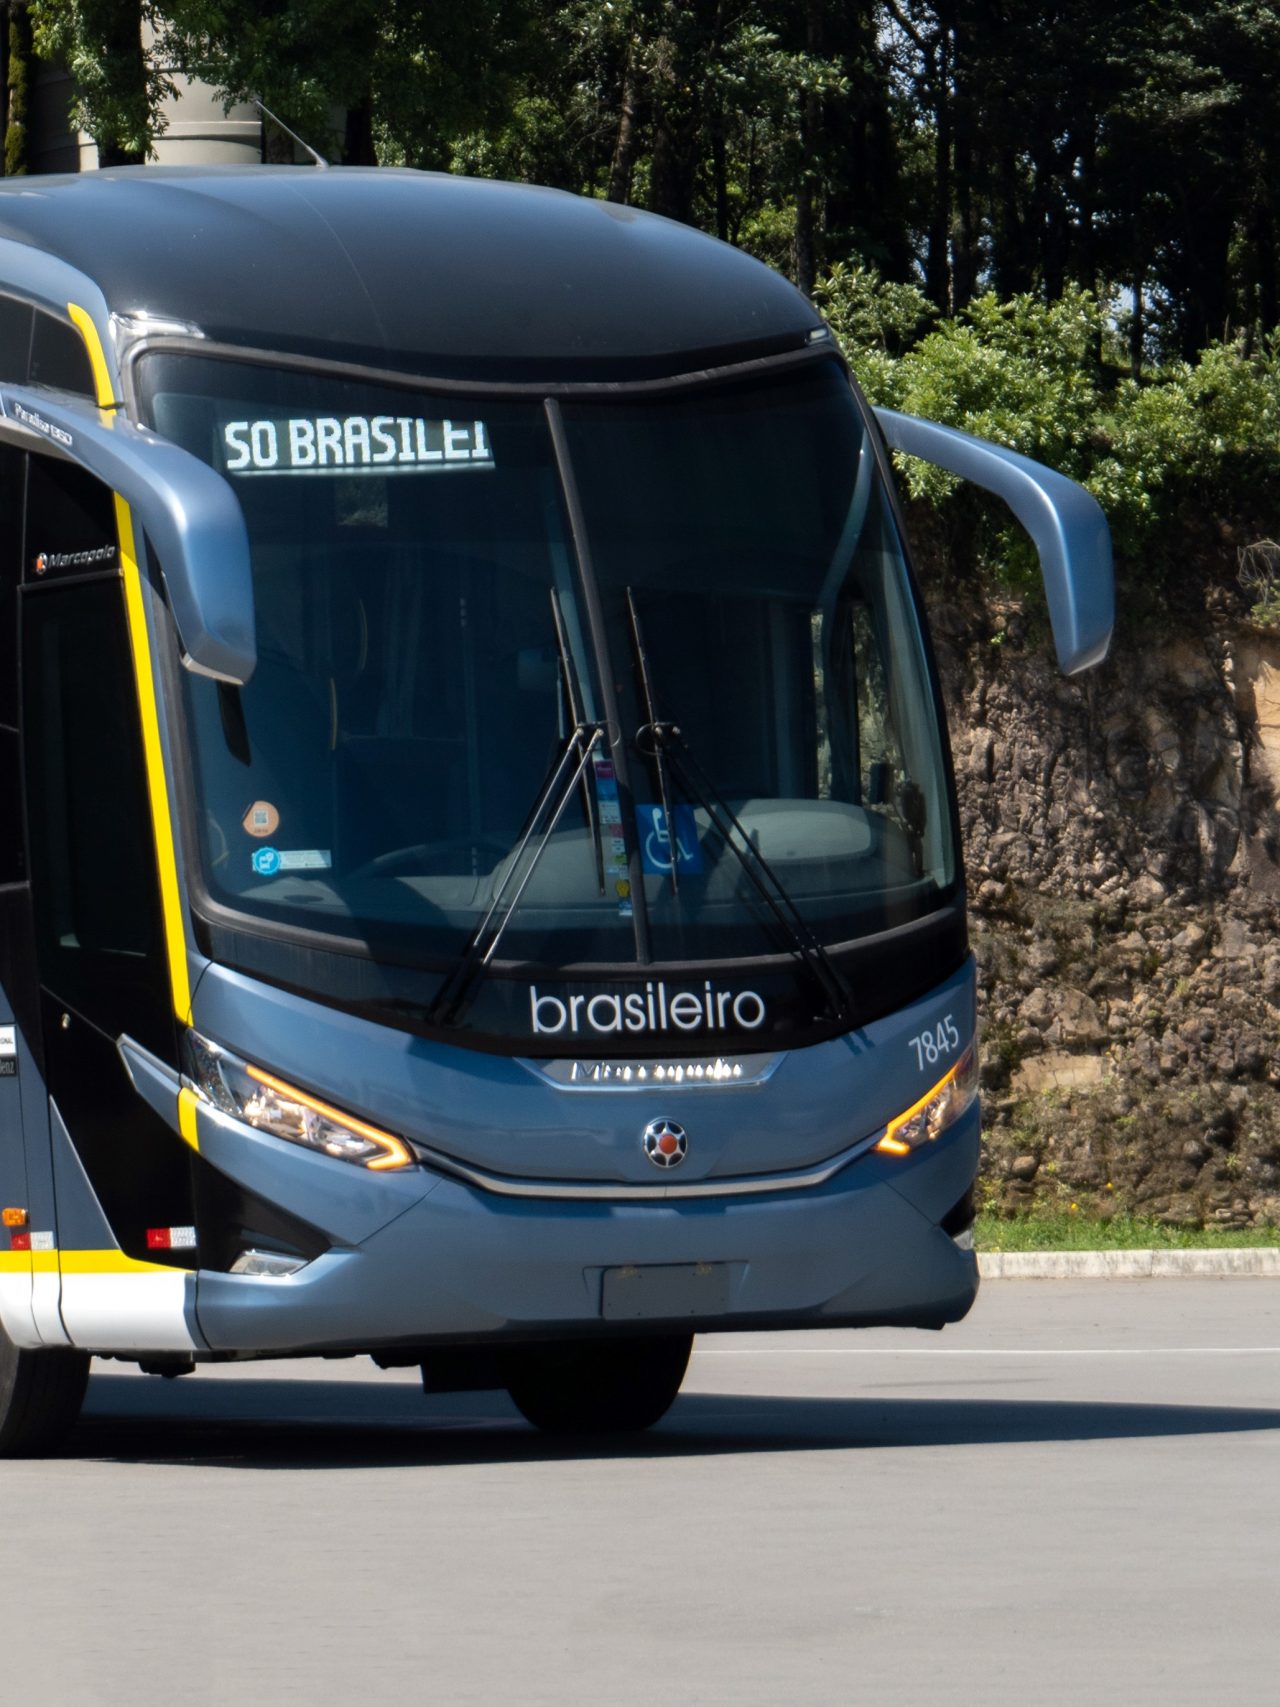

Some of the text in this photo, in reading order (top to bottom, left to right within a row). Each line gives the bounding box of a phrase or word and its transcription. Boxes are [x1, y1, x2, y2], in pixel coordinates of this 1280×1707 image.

[225, 420, 278, 469] SO
[48, 544, 116, 568] Marcopolo
[529, 981, 766, 1033] brasileiro
[908, 1014, 959, 1071] 7845
